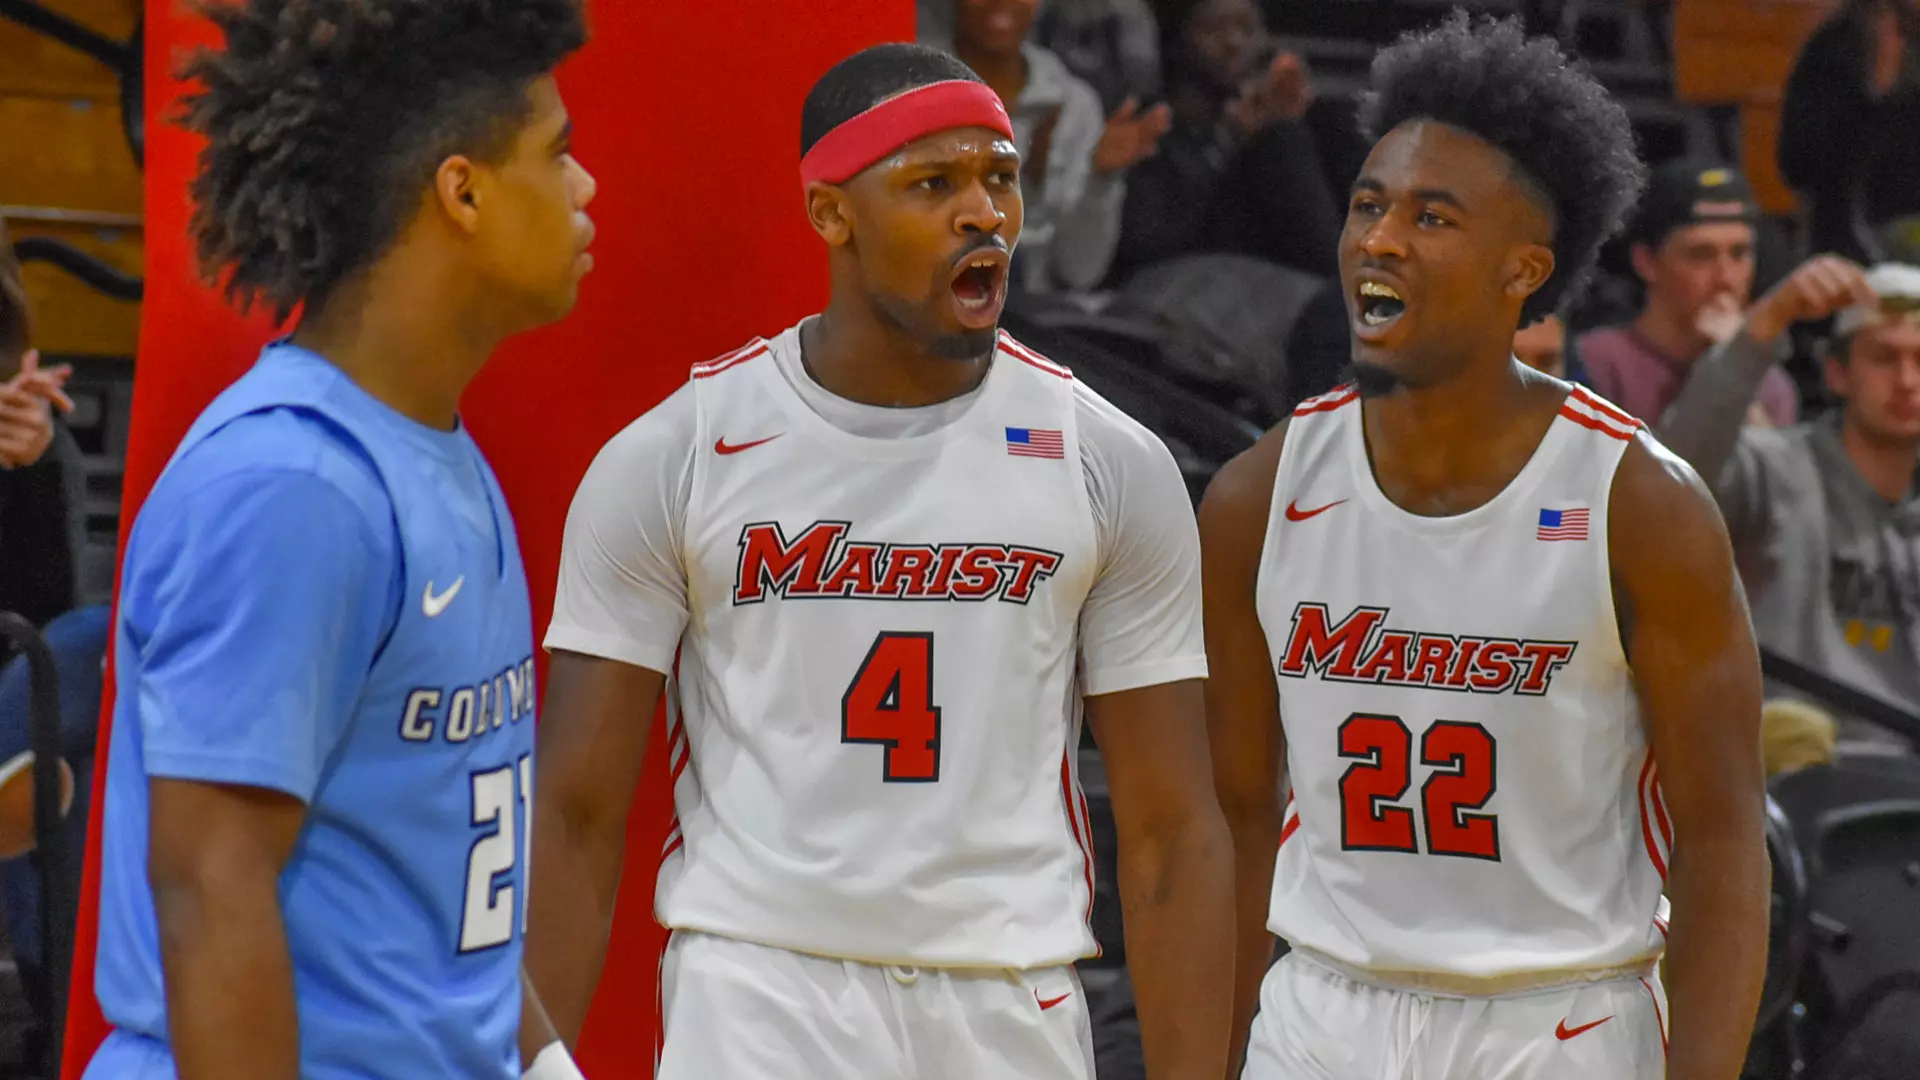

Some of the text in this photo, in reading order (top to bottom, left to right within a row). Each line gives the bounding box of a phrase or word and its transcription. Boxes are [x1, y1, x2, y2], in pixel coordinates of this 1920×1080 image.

[733, 520, 1064, 605] MARIST
[841, 631, 941, 783] 4
[1279, 602, 1579, 696] MARIST
[1338, 712, 1501, 863] 22
